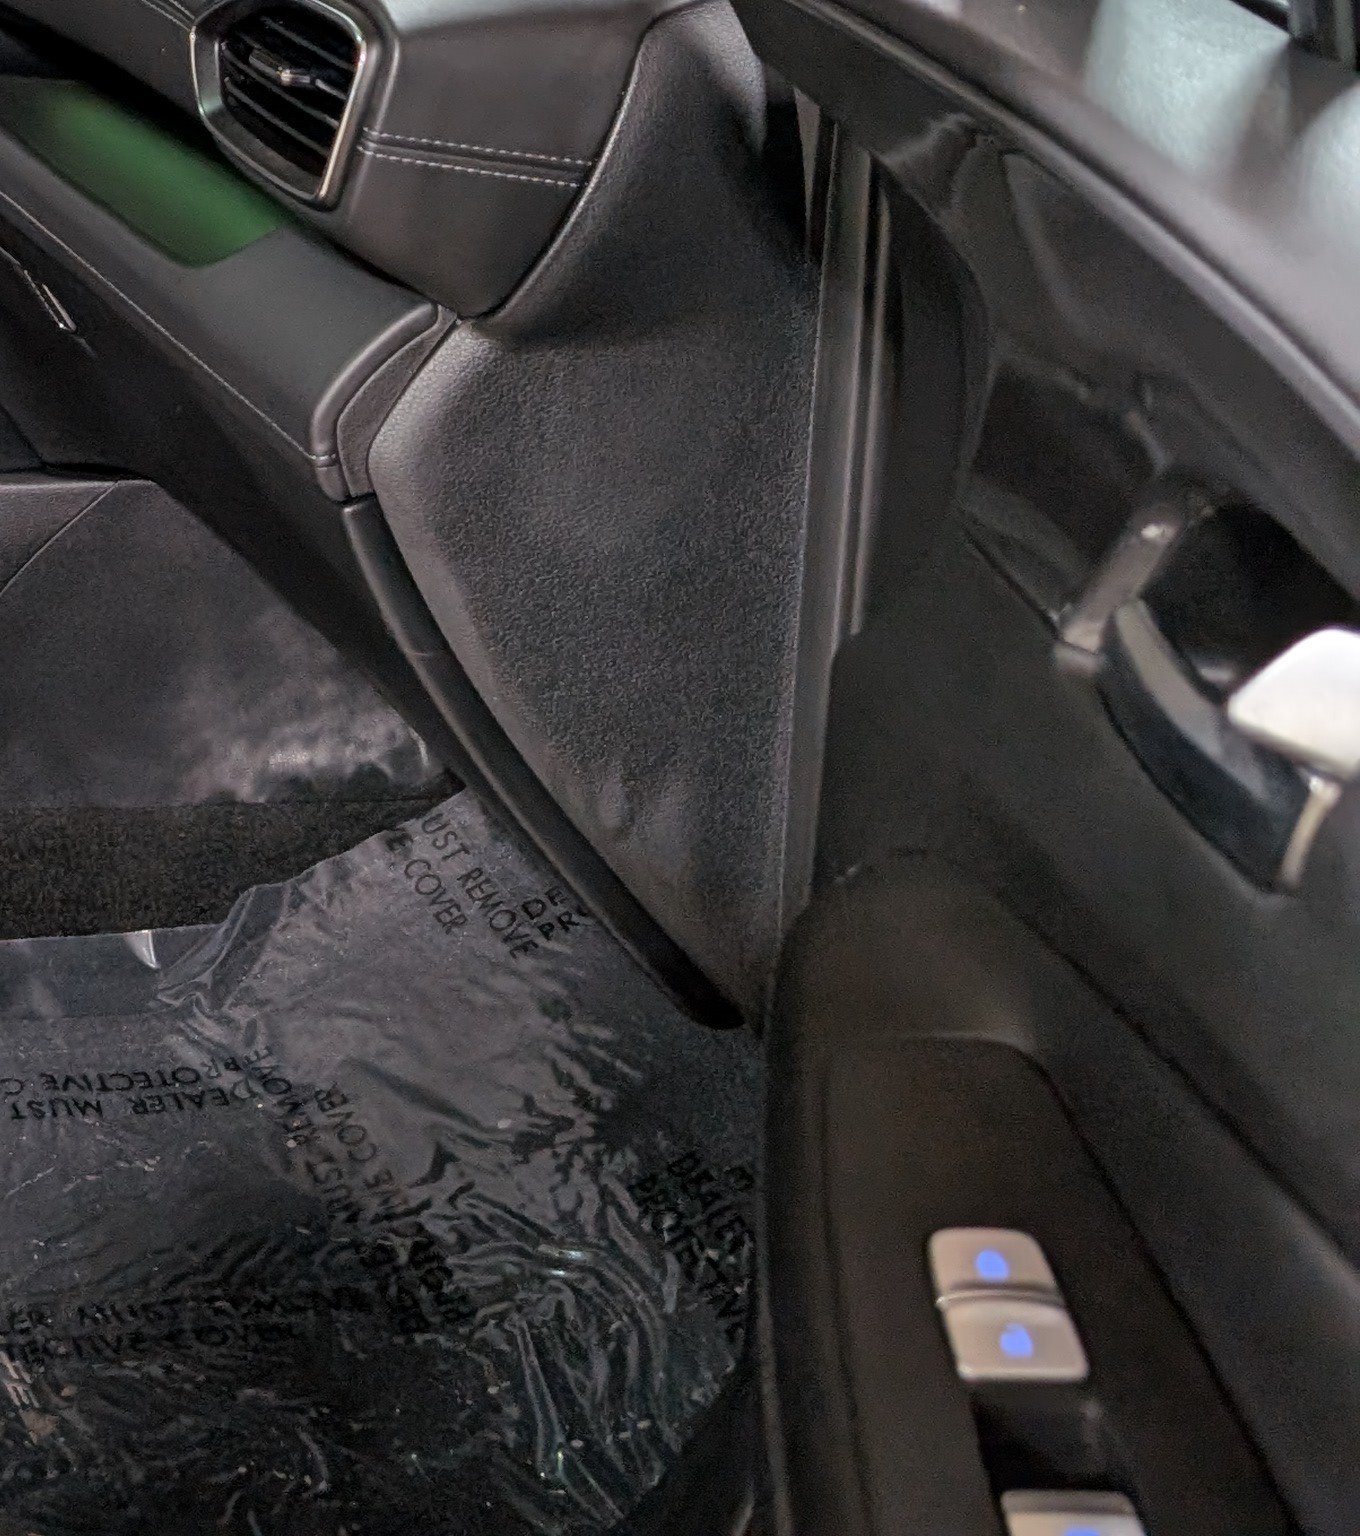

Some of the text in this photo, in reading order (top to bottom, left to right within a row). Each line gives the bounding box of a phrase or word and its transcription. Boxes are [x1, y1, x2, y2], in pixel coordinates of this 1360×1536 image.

[404, 859, 468, 935] COVER
[421, 813, 539, 959] UST REMOVE
[39, 1056, 242, 1092] PROTECTIVE
[10, 1095, 103, 1120] MUST
[130, 1078, 257, 1115] DEALER
